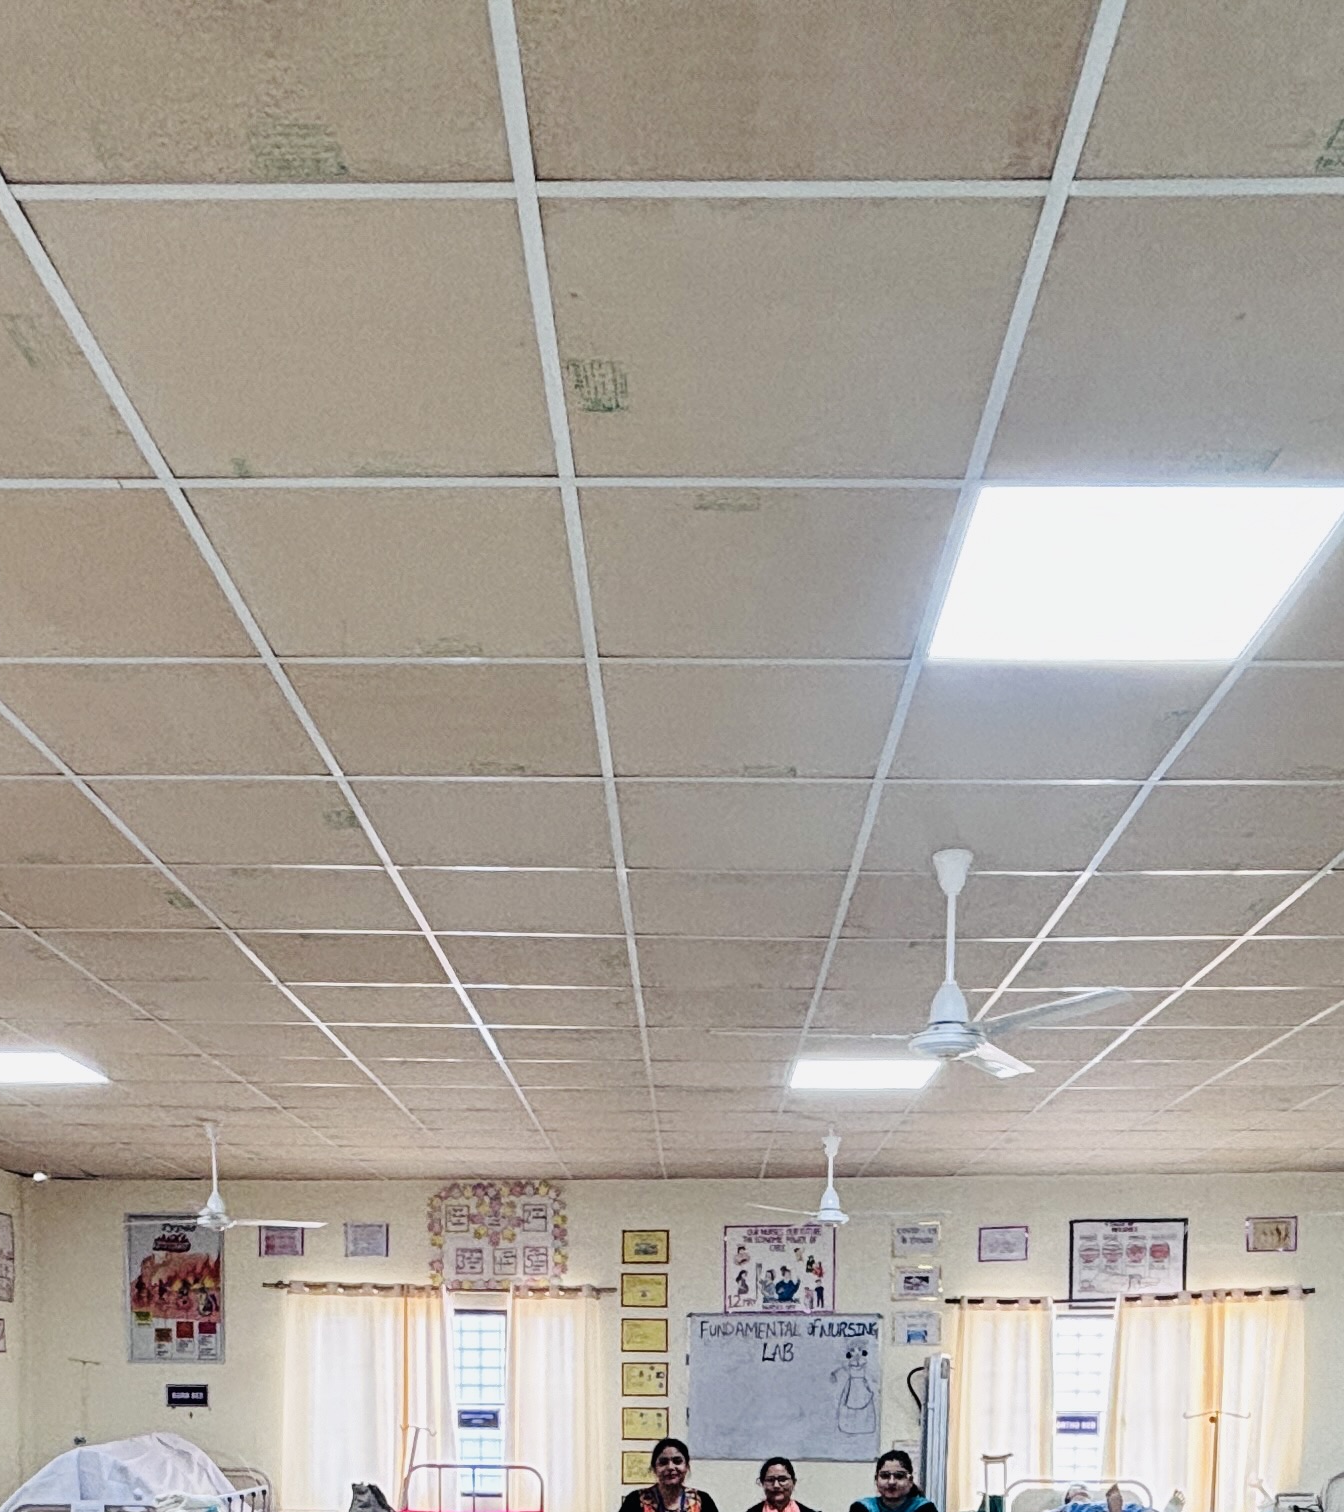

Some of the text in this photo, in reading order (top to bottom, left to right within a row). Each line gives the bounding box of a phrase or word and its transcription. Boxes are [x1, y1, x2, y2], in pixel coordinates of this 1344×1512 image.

[700, 1321, 801, 1339] FUNDAMENTAL
[819, 1322, 879, 1339] NURSING
[762, 1342, 795, 1362] LAB
